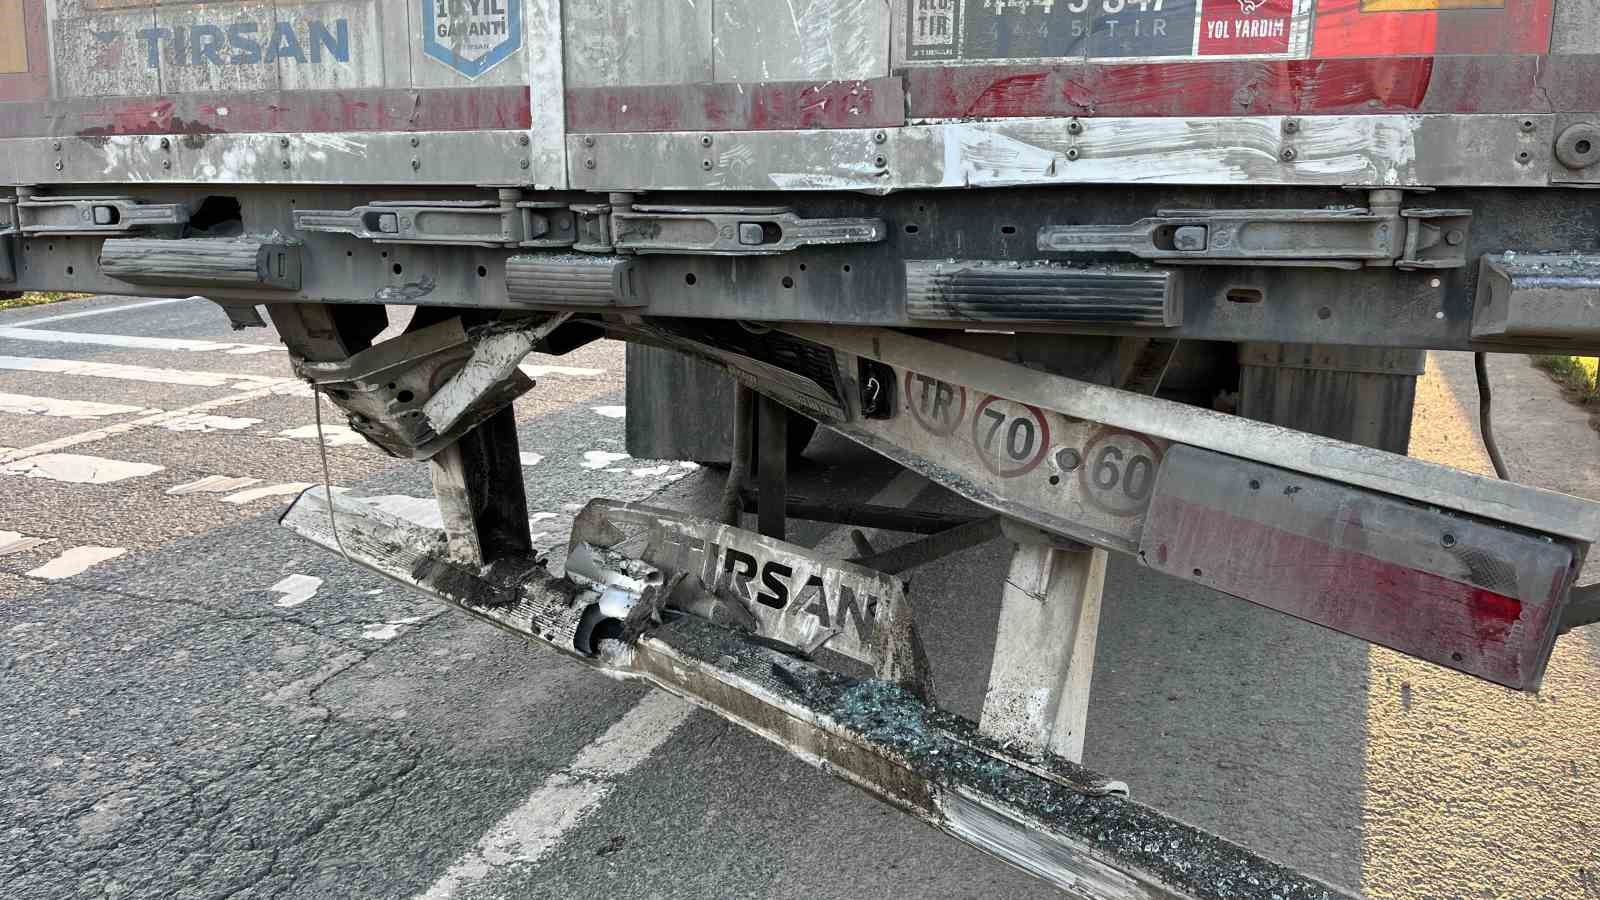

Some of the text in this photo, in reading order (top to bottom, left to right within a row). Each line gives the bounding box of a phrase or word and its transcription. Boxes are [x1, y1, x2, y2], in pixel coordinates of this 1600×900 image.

[437, 0, 505, 17] 1 YIL
[438, 16, 506, 37] GAANTİ
[1207, 19, 1284, 39] YOL YARDIM
[136, 18, 350, 69] TIRSAN
[916, 373, 955, 422] TR
[984, 408, 1035, 460] 70
[1092, 446, 1151, 500] 60
